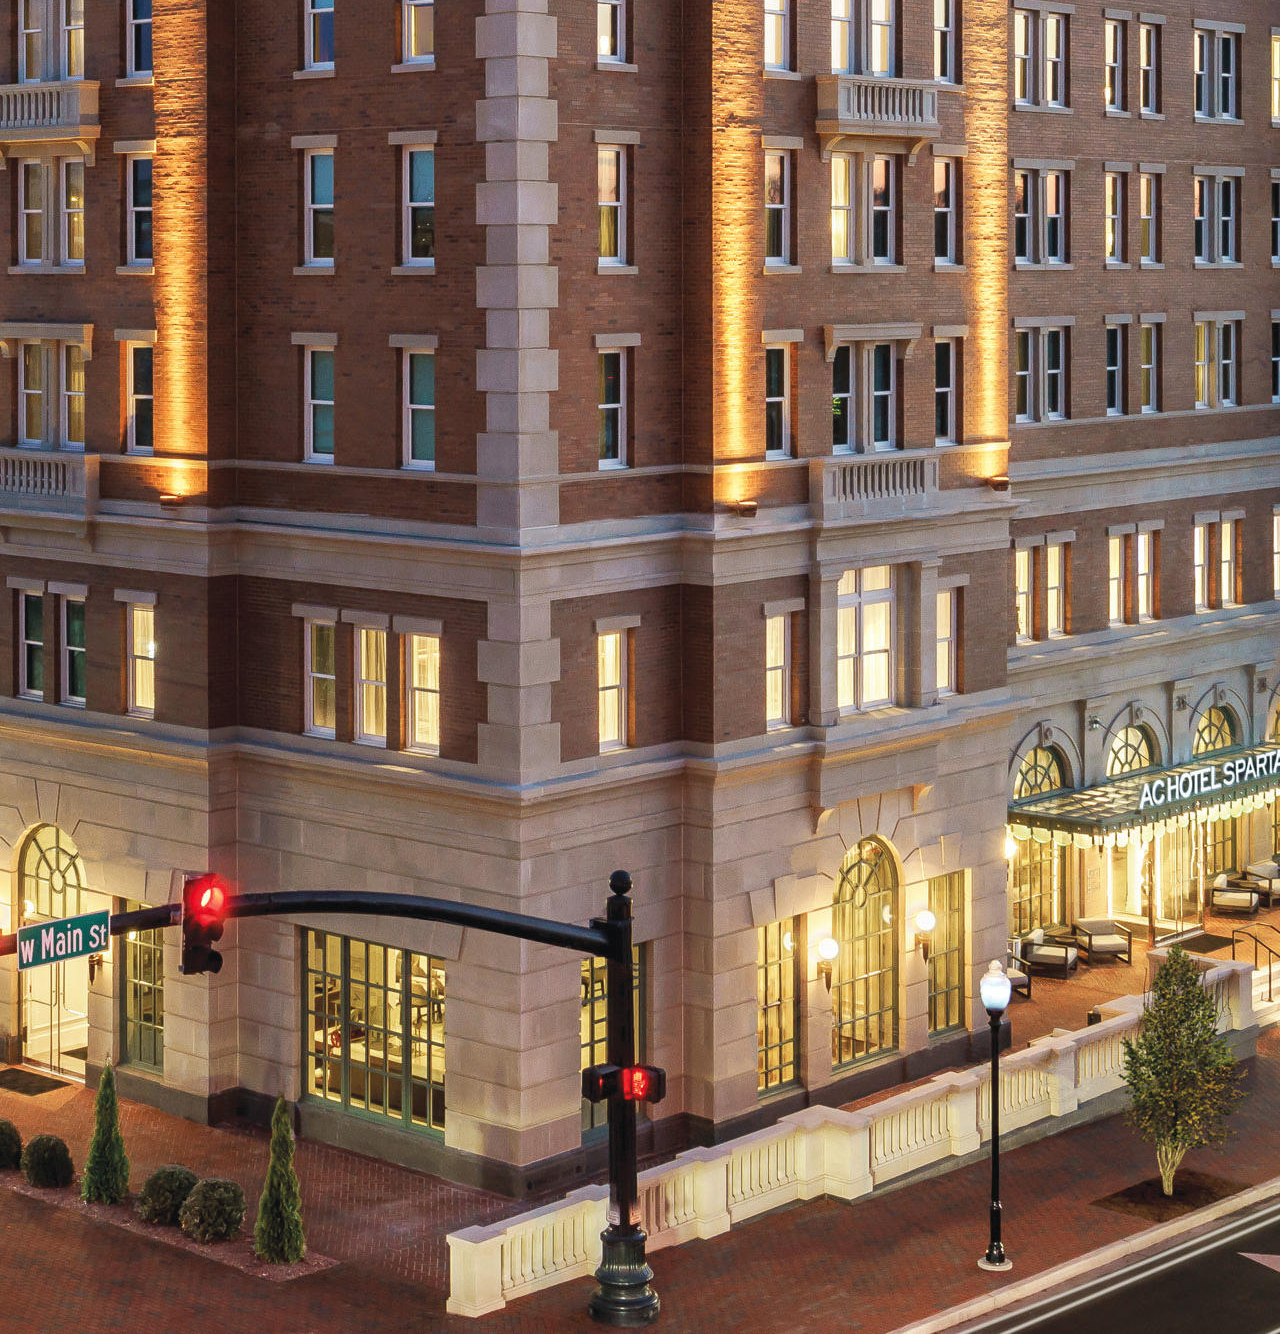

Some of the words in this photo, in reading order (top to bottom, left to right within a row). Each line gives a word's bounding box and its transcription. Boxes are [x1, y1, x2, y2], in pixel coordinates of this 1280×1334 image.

[1139, 779, 1165, 810] AC
[1167, 766, 1222, 802] HOTEL
[41, 923, 83, 960] Main
[89, 923, 107, 948] St
